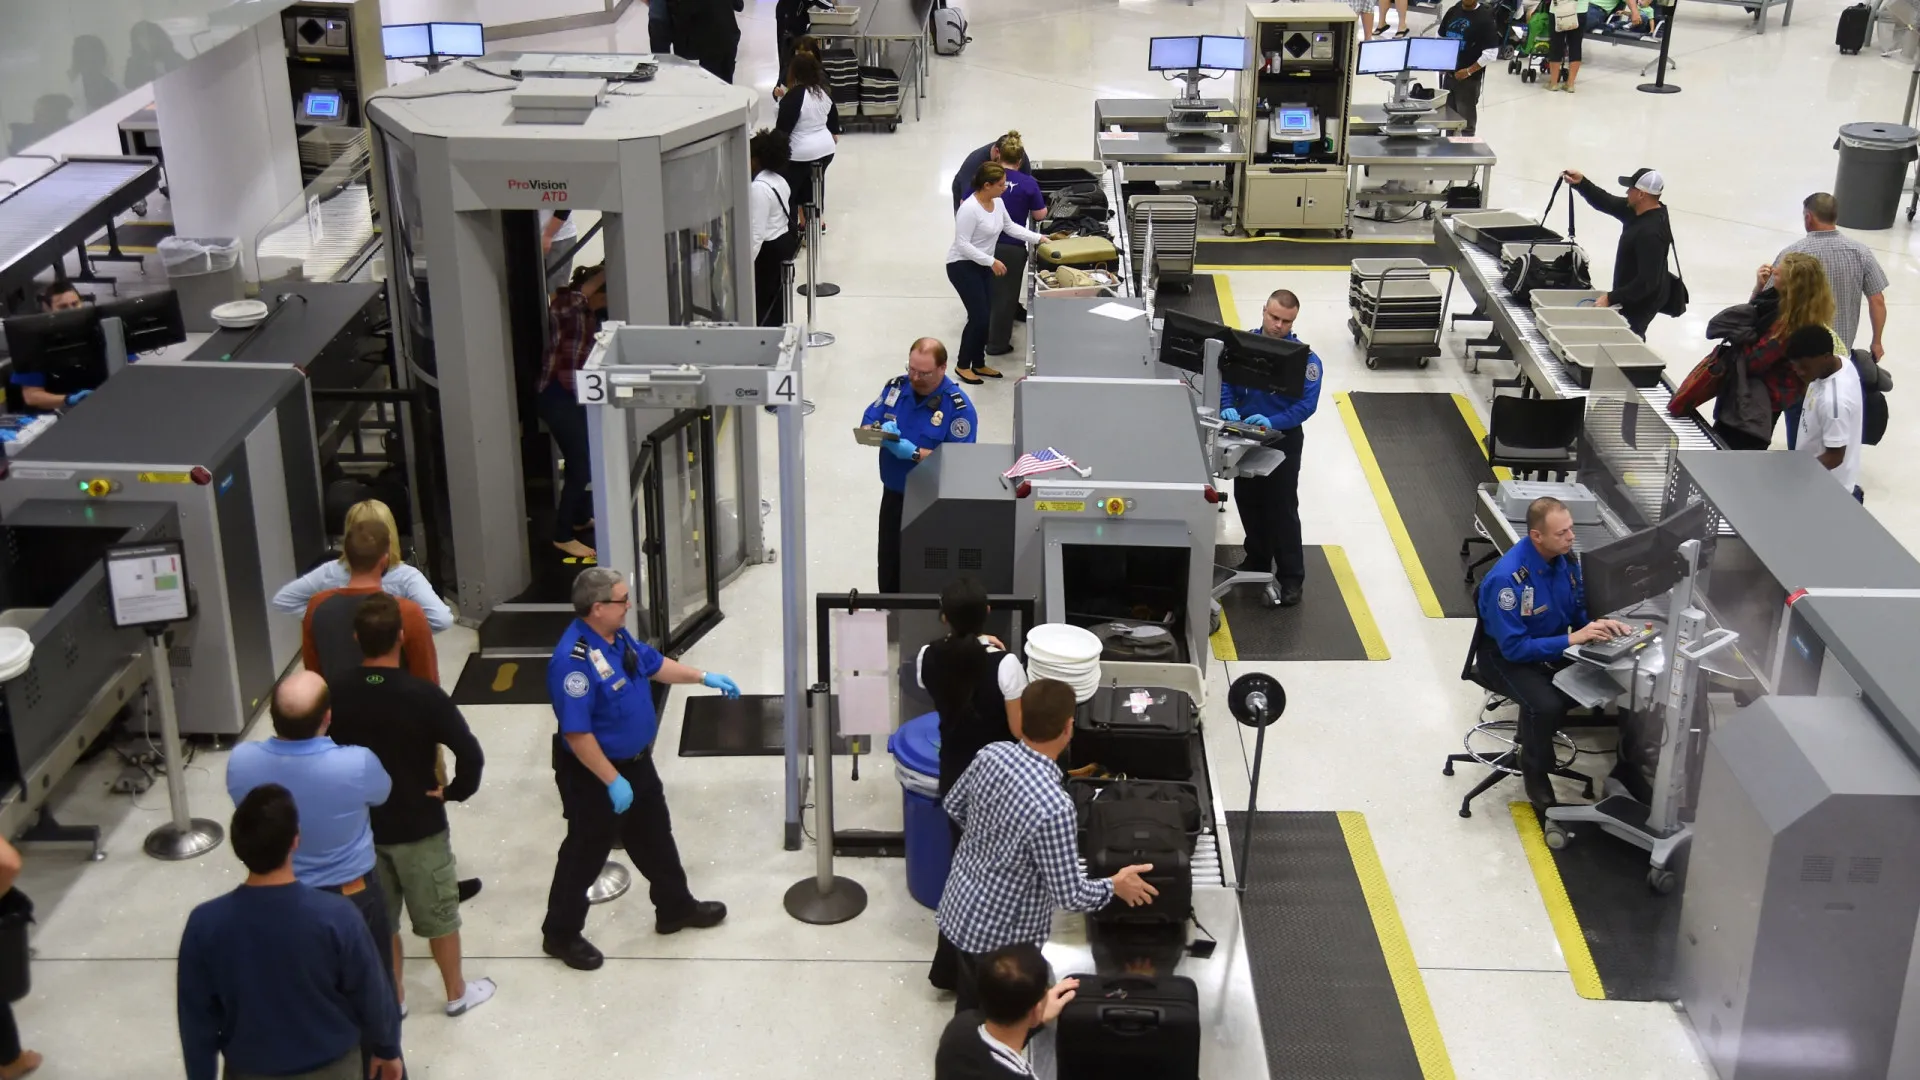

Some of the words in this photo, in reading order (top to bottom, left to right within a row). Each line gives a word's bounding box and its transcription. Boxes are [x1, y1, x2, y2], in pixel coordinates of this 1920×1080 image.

[508, 179, 568, 190] ProVision
[541, 191, 568, 203] ATD
[585, 374, 604, 402] 3
[775, 374, 796, 402] 4
